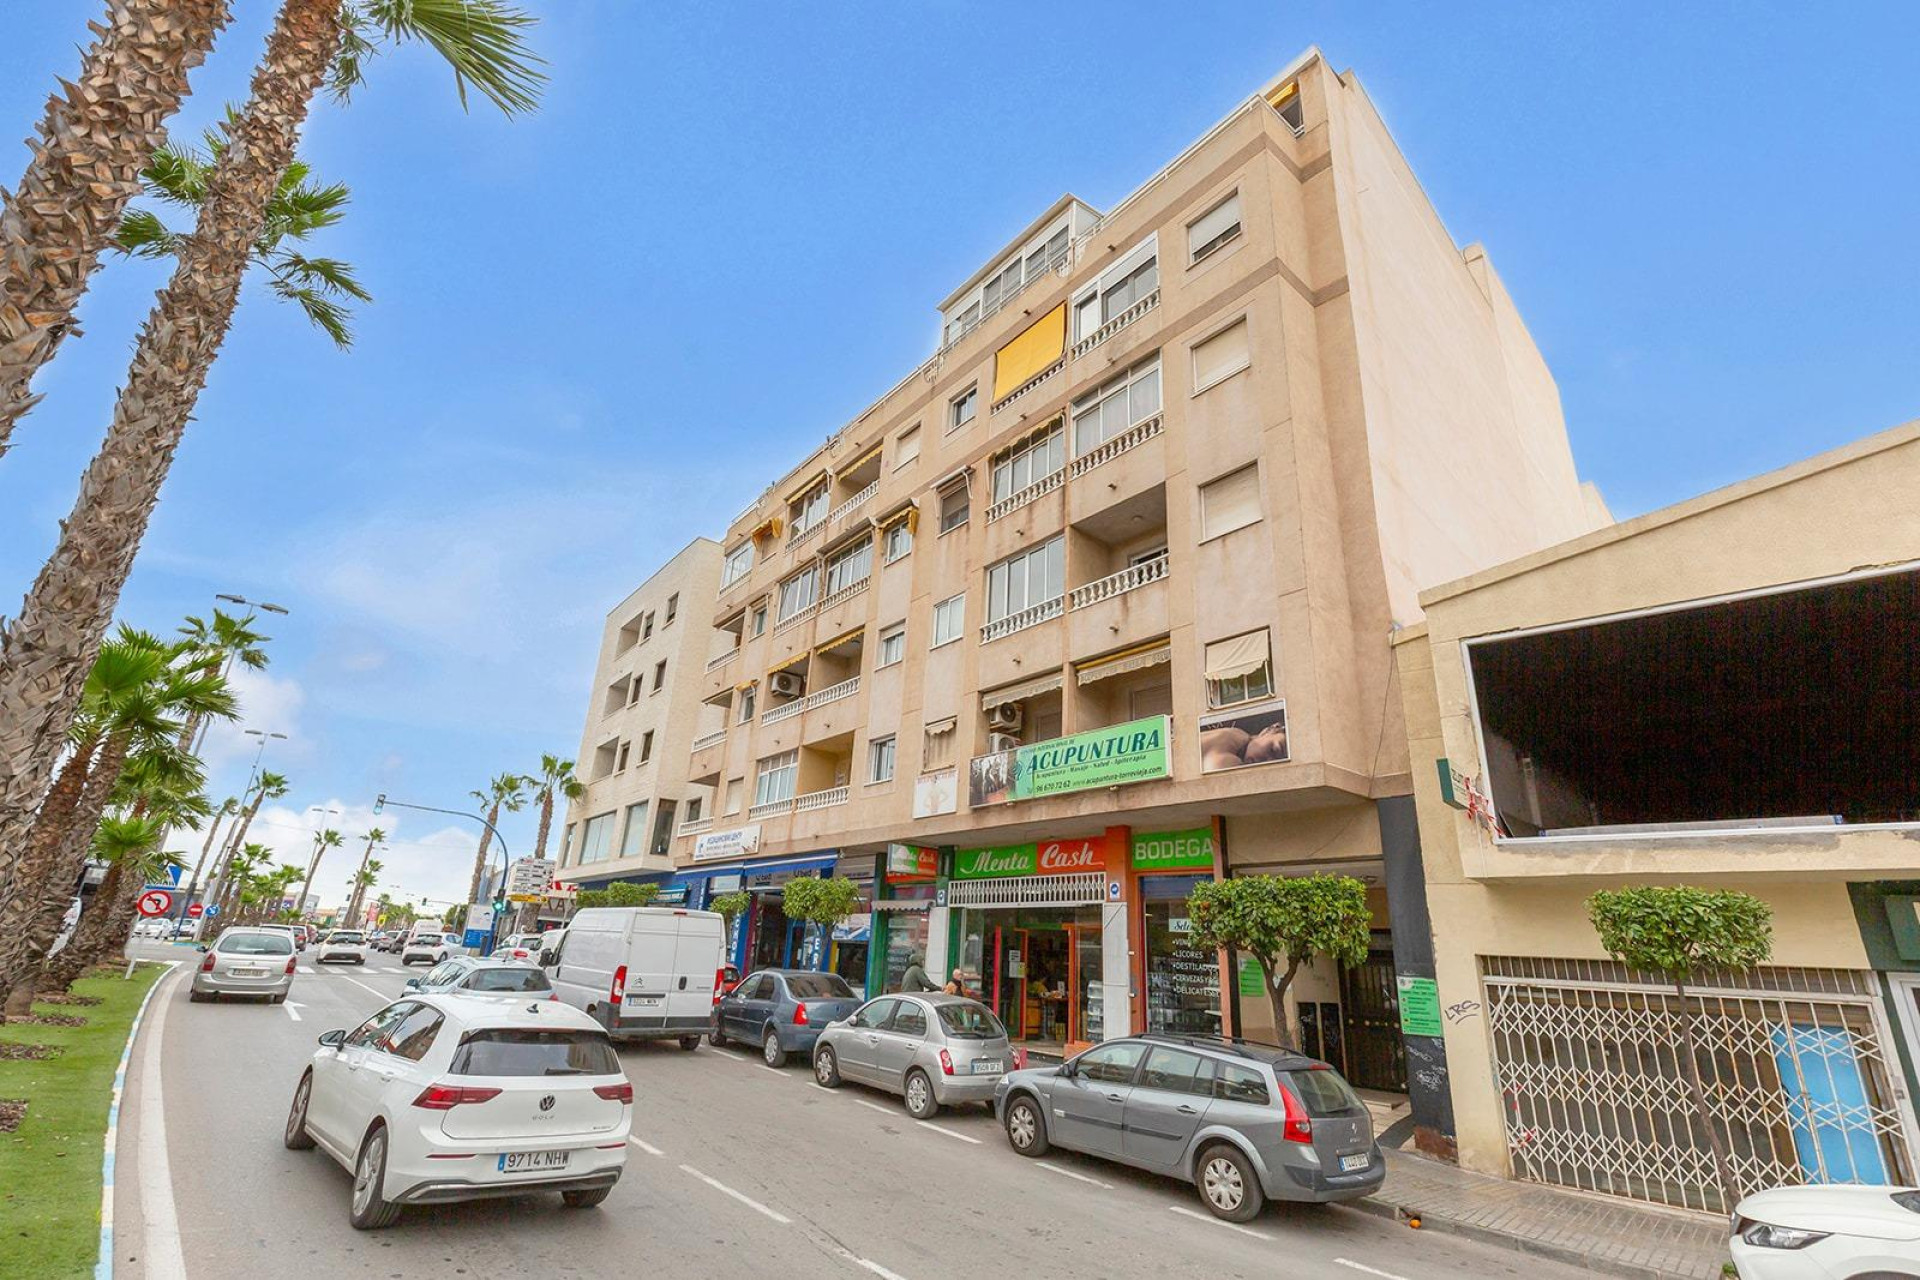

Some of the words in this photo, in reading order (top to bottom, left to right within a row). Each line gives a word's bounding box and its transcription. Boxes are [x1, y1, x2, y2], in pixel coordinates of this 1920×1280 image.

[1026, 729, 1159, 775] ACUPUNTURA
[960, 851, 1032, 874] Menta
[1041, 842, 1105, 868] Cash
[1135, 837, 1213, 861] BODEGA
[507, 1152, 541, 1168] 9714
[545, 1151, 570, 1166] NHW
